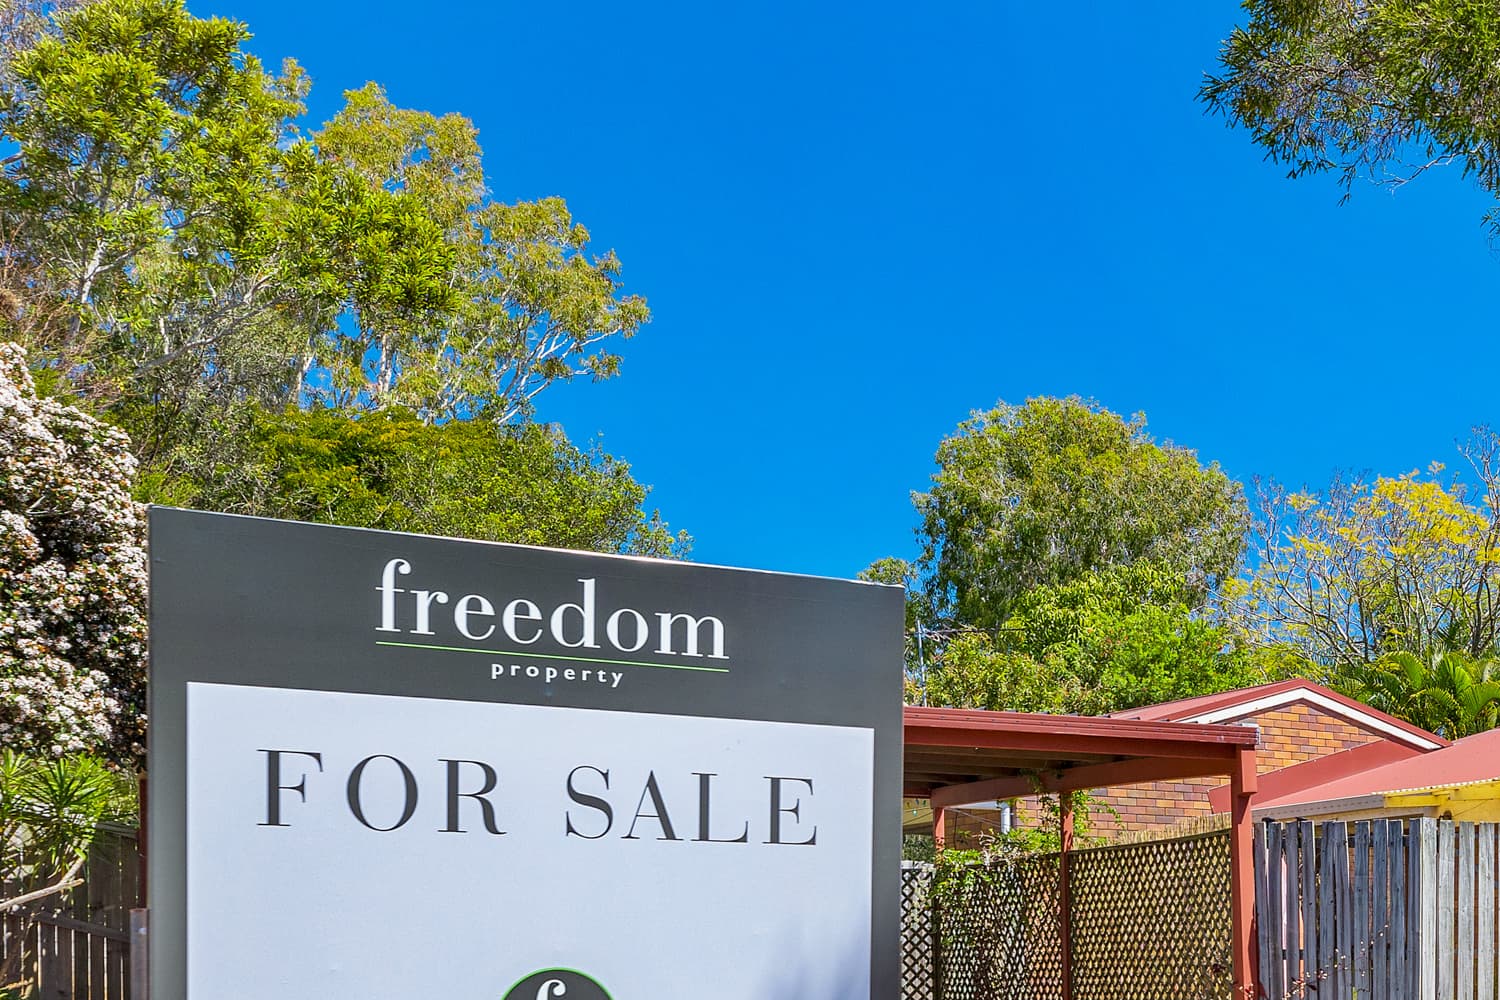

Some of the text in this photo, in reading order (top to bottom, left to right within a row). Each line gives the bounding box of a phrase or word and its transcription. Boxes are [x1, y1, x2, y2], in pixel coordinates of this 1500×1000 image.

[375, 557, 730, 660] freedom
[491, 661, 624, 689] property
[256, 748, 817, 847] FOR SALE
